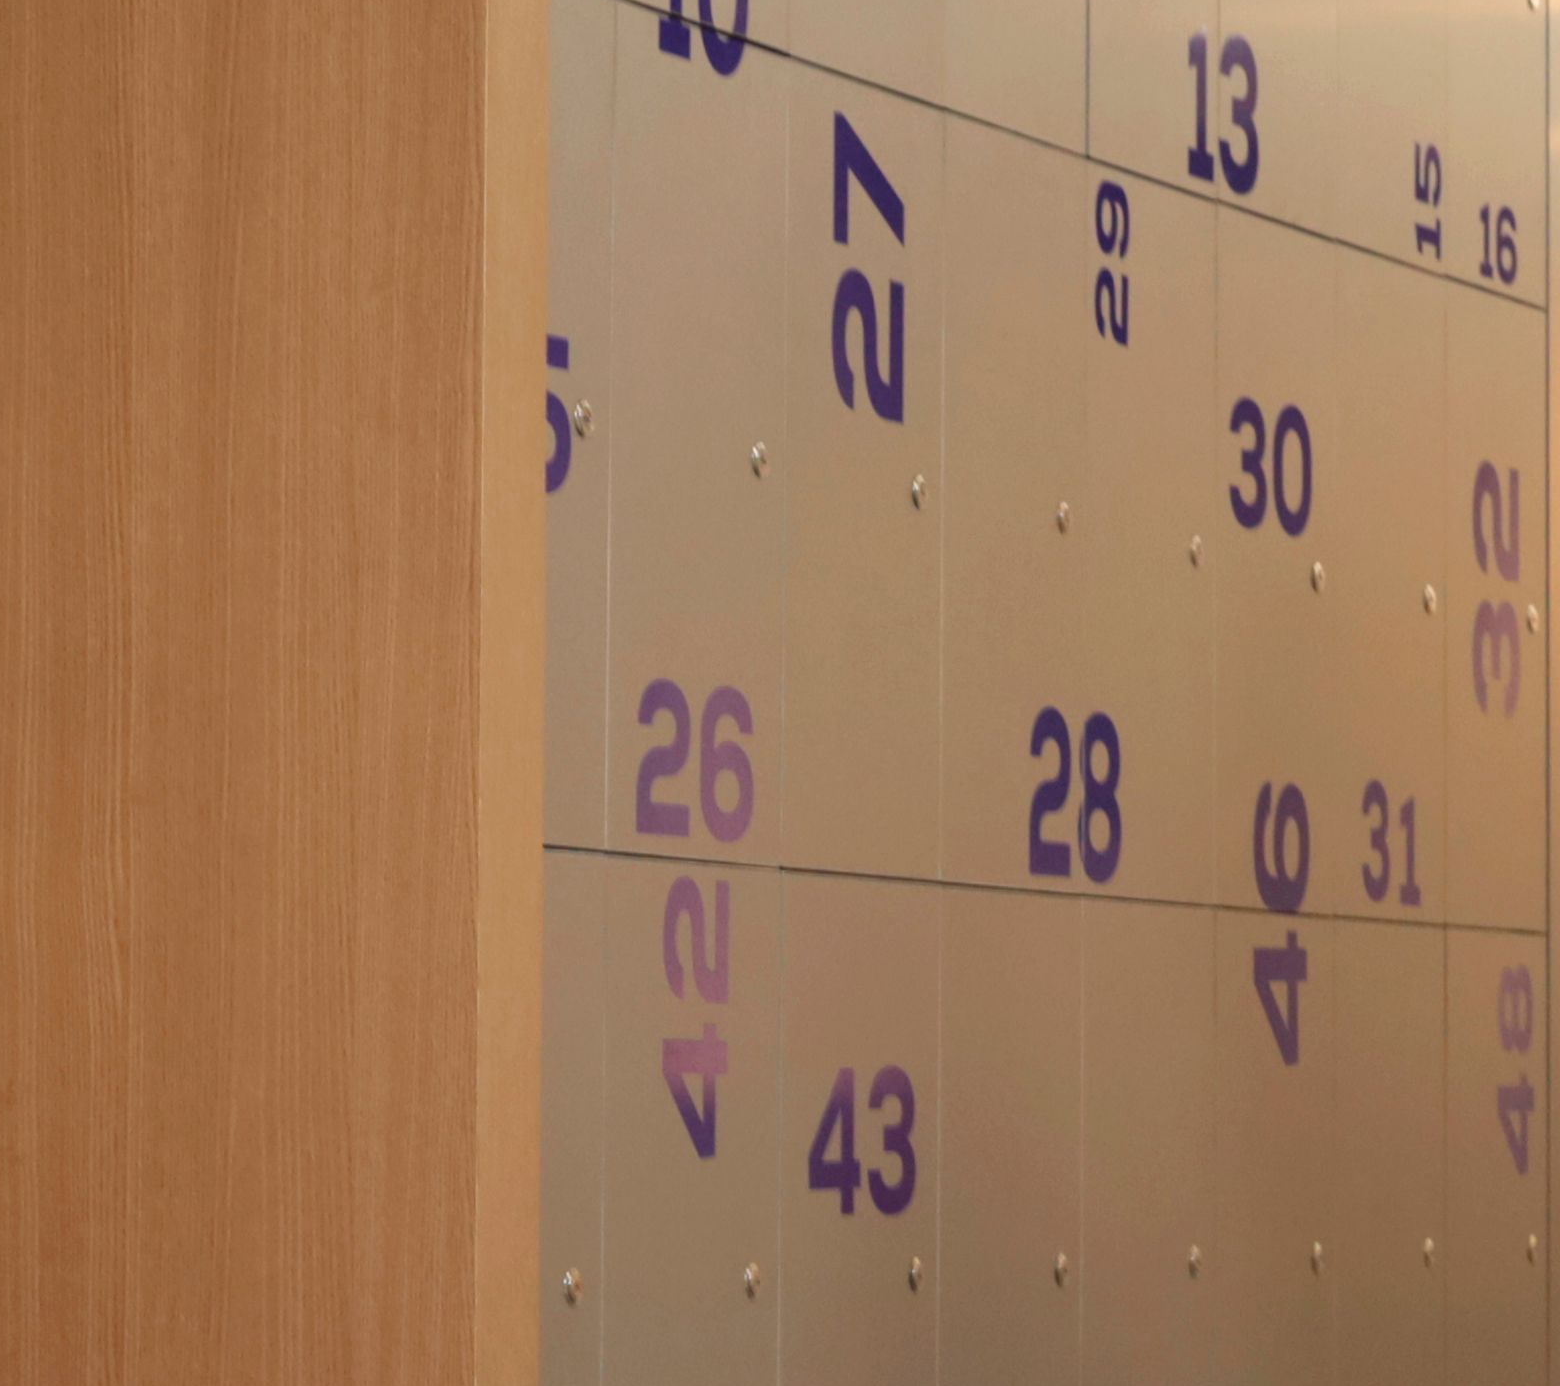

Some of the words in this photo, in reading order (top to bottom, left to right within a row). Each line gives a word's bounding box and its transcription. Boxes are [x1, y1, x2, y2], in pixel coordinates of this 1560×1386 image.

[1187, 25, 1259, 195] 13
[831, 110, 905, 424] 27
[1095, 179, 1130, 347] 29
[1414, 141, 1443, 261] 15
[1479, 204, 1519, 287] 16
[1228, 396, 1313, 537] 30
[1472, 460, 1522, 718] 32
[635, 678, 754, 843] 26
[1029, 706, 1122, 883] 28
[1361, 778, 1422, 907] 31
[1253, 781, 1311, 1067] 46
[662, 874, 731, 1159] 42
[1497, 964, 1536, 1176] 48
[808, 1064, 916, 1216] 43
